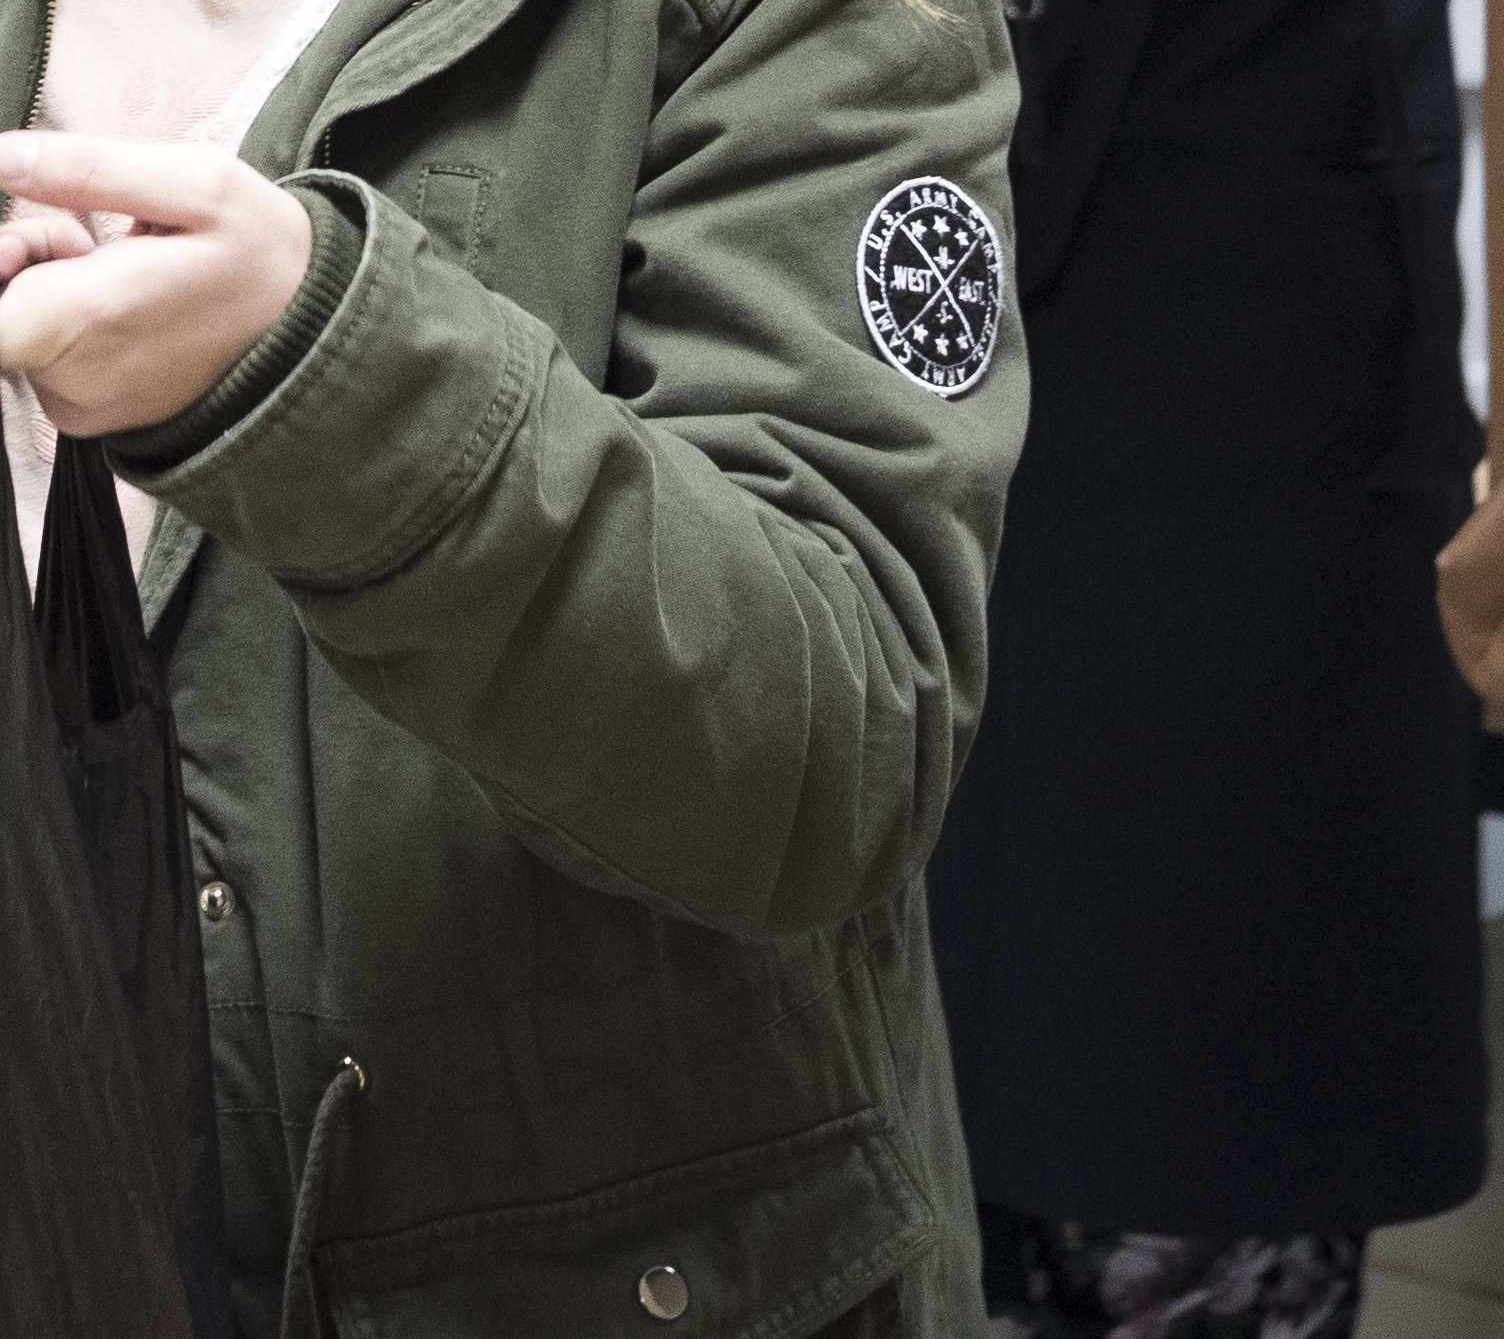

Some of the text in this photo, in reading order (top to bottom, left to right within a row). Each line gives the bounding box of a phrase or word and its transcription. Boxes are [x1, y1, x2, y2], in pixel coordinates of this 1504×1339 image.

[910, 187, 958, 209] ARMY
[890, 265, 932, 294] WEST
[869, 300, 912, 364] CAMP
